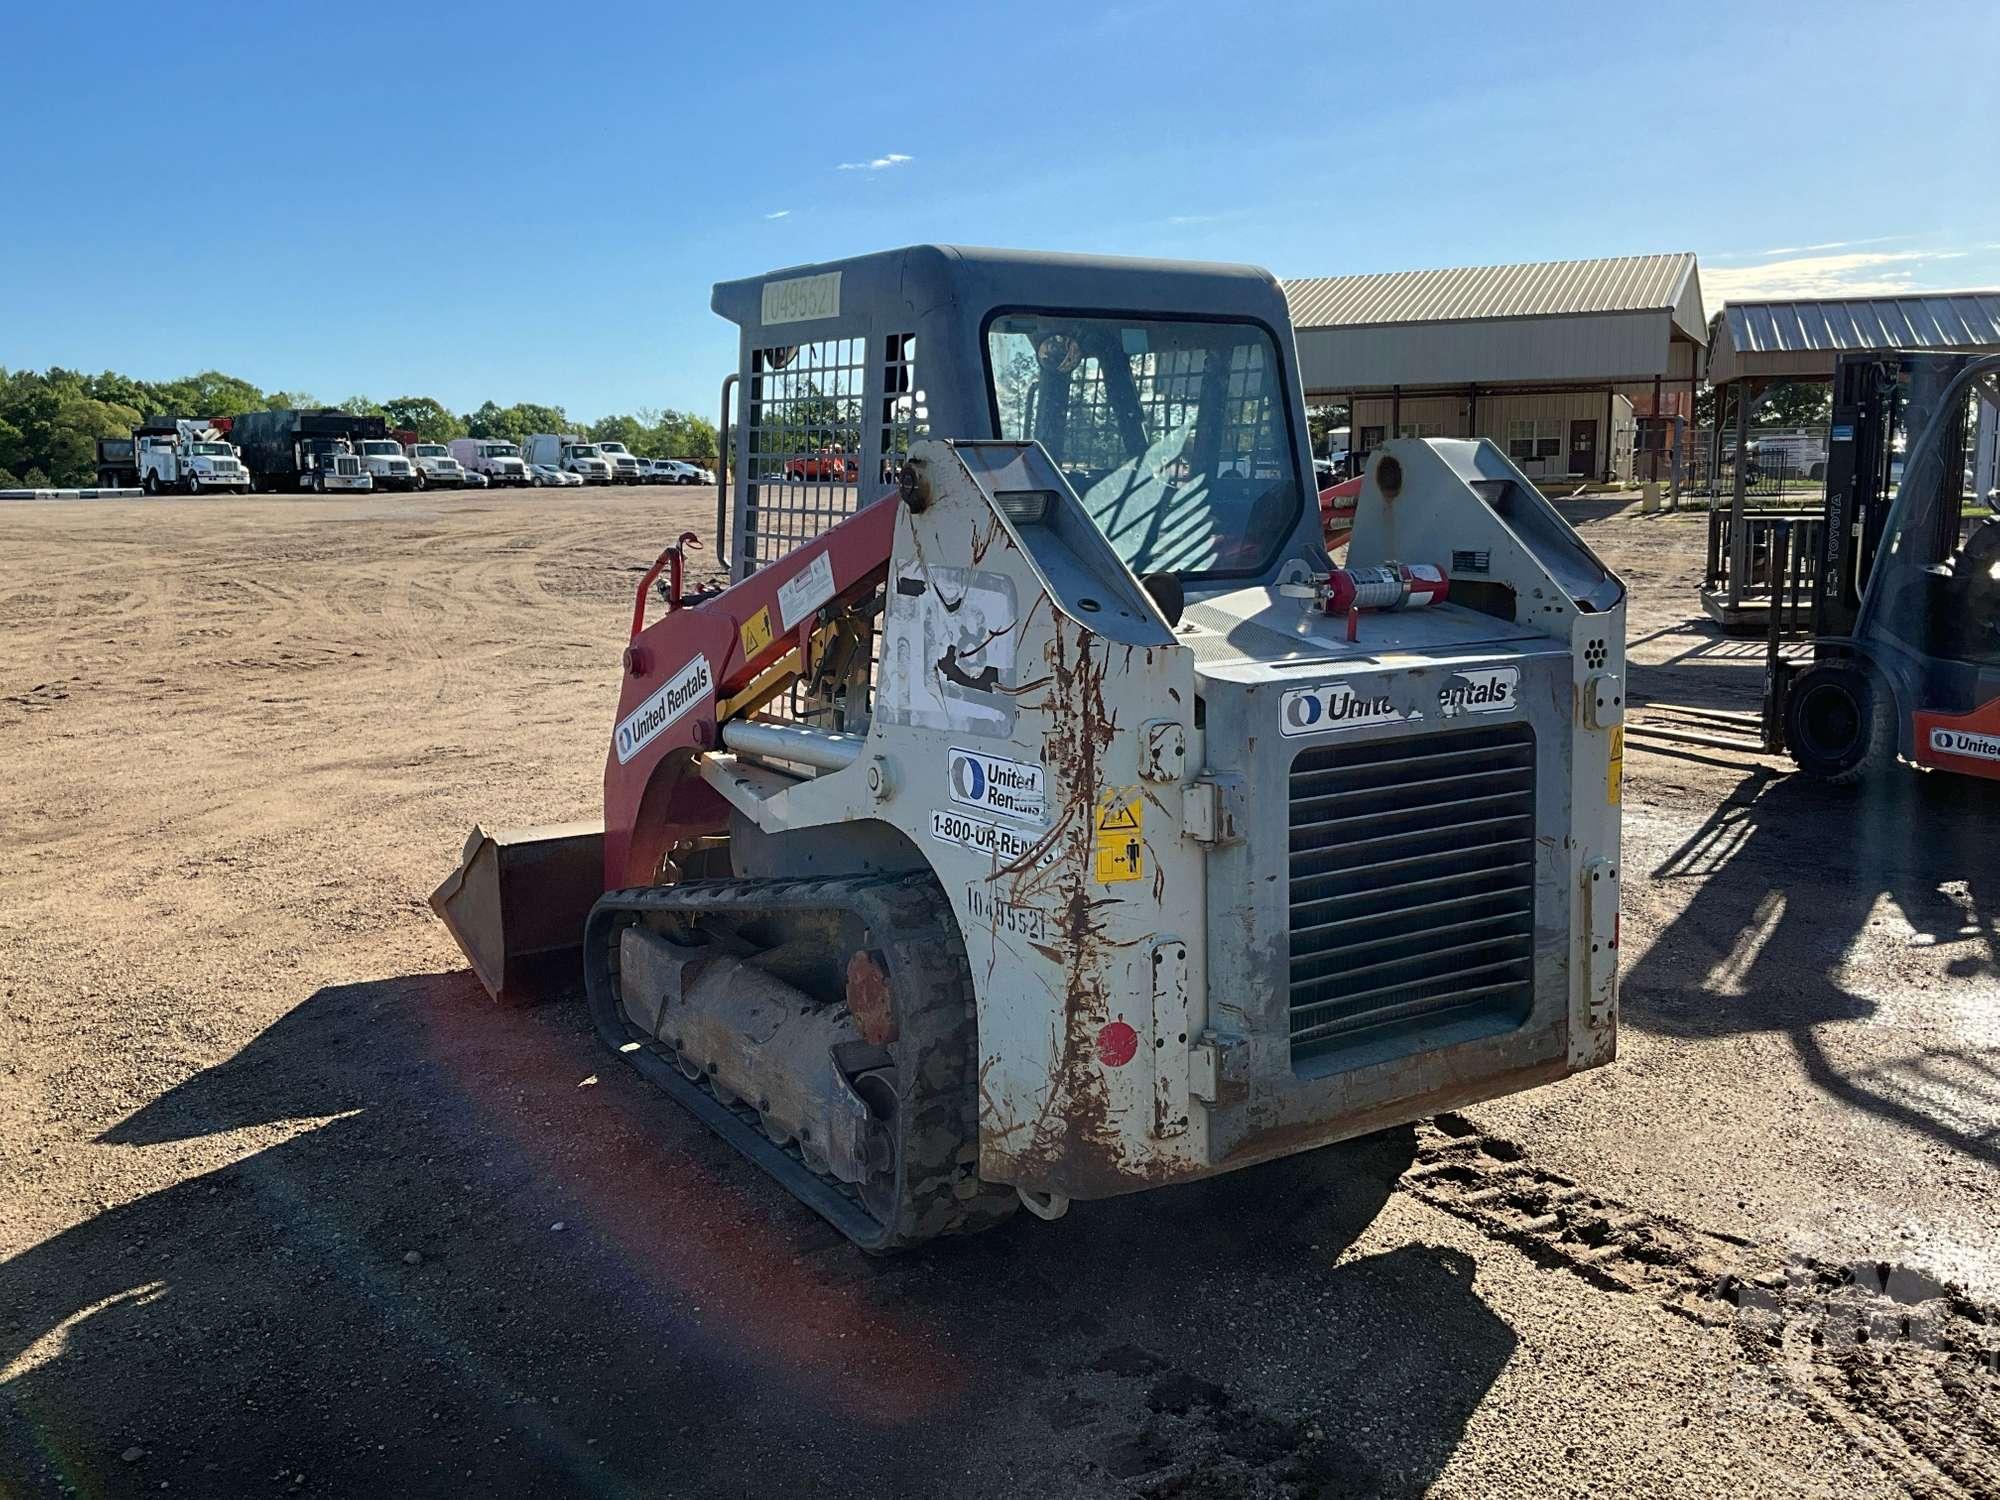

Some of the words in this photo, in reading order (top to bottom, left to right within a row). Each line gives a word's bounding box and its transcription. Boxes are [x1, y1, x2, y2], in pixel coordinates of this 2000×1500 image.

[1827, 493, 1842, 562] TOYOTA
[632, 697, 667, 743] United
[667, 666, 708, 715] Rentals
[1439, 677, 1508, 706] entals
[1957, 736, 2000, 755] Unite
[988, 764, 1036, 791] United
